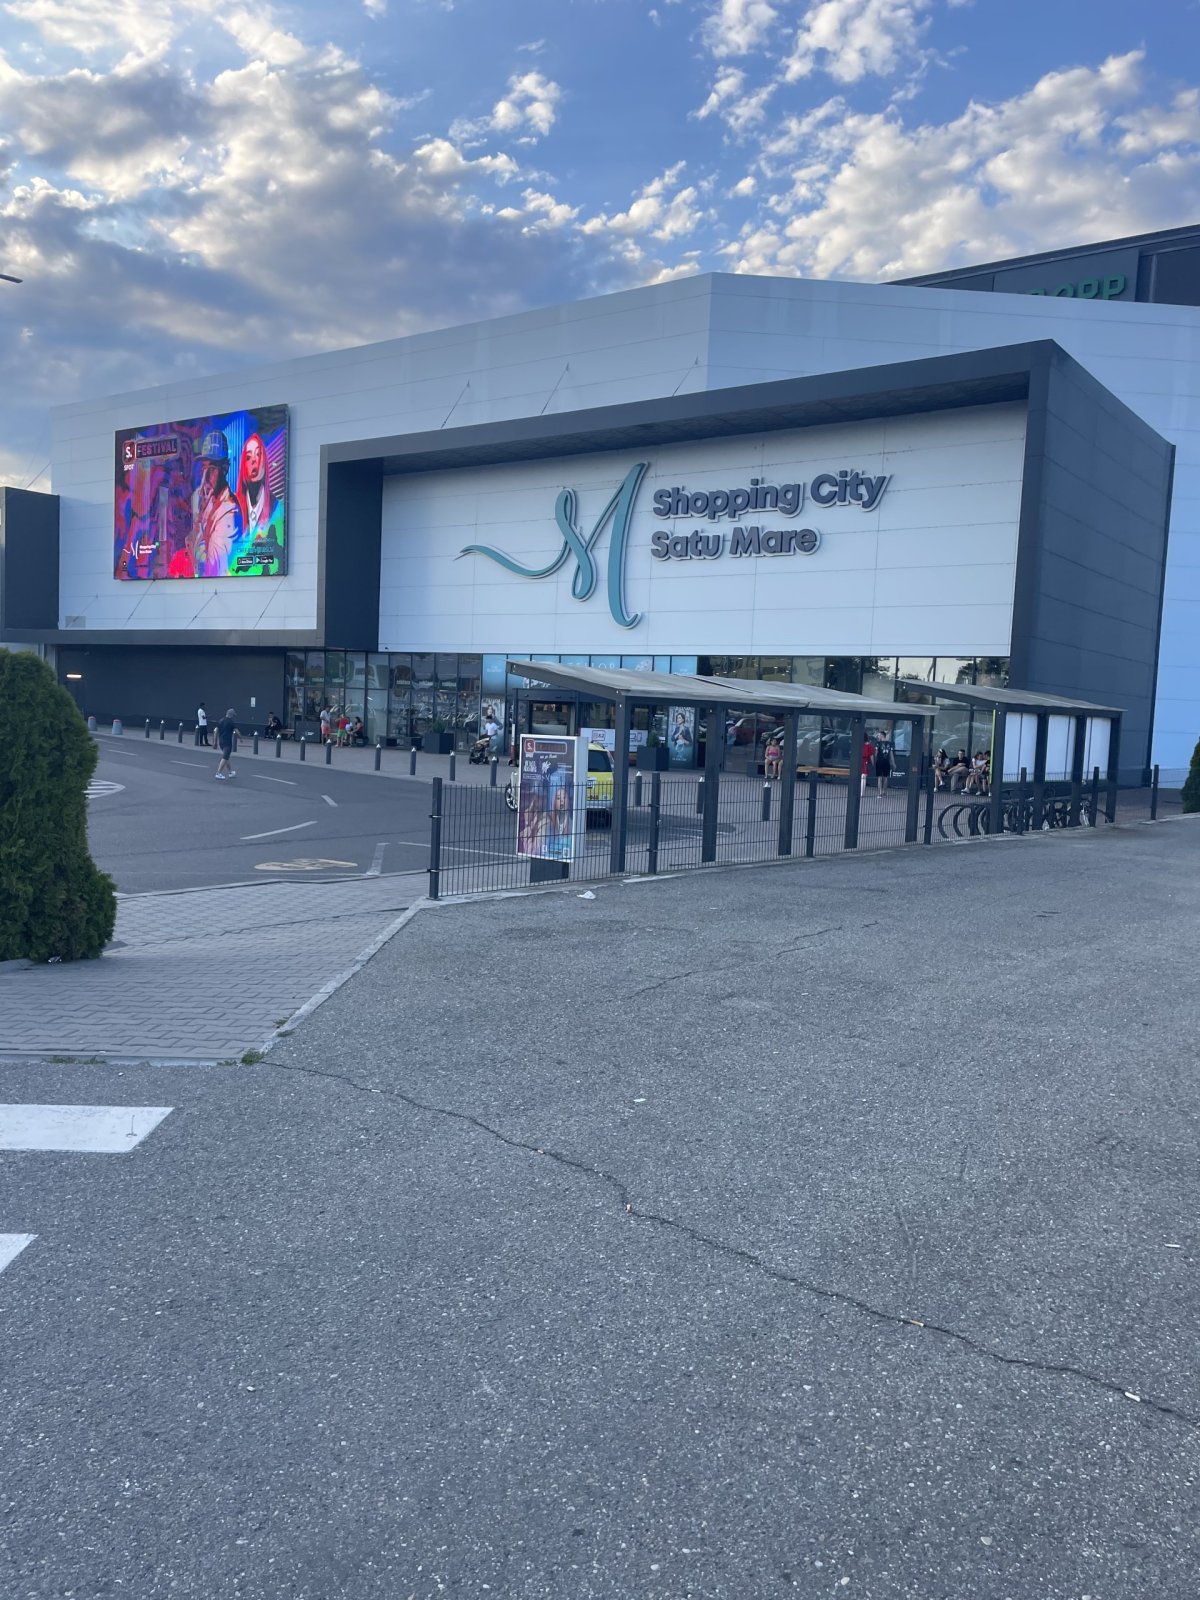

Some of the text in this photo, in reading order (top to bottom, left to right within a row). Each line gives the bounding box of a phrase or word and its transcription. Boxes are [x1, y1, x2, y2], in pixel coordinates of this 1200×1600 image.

[137, 440, 177, 456] FESTIVAL
[652, 468, 893, 522] Shopping City
[650, 525, 821, 561] Satu Mare
